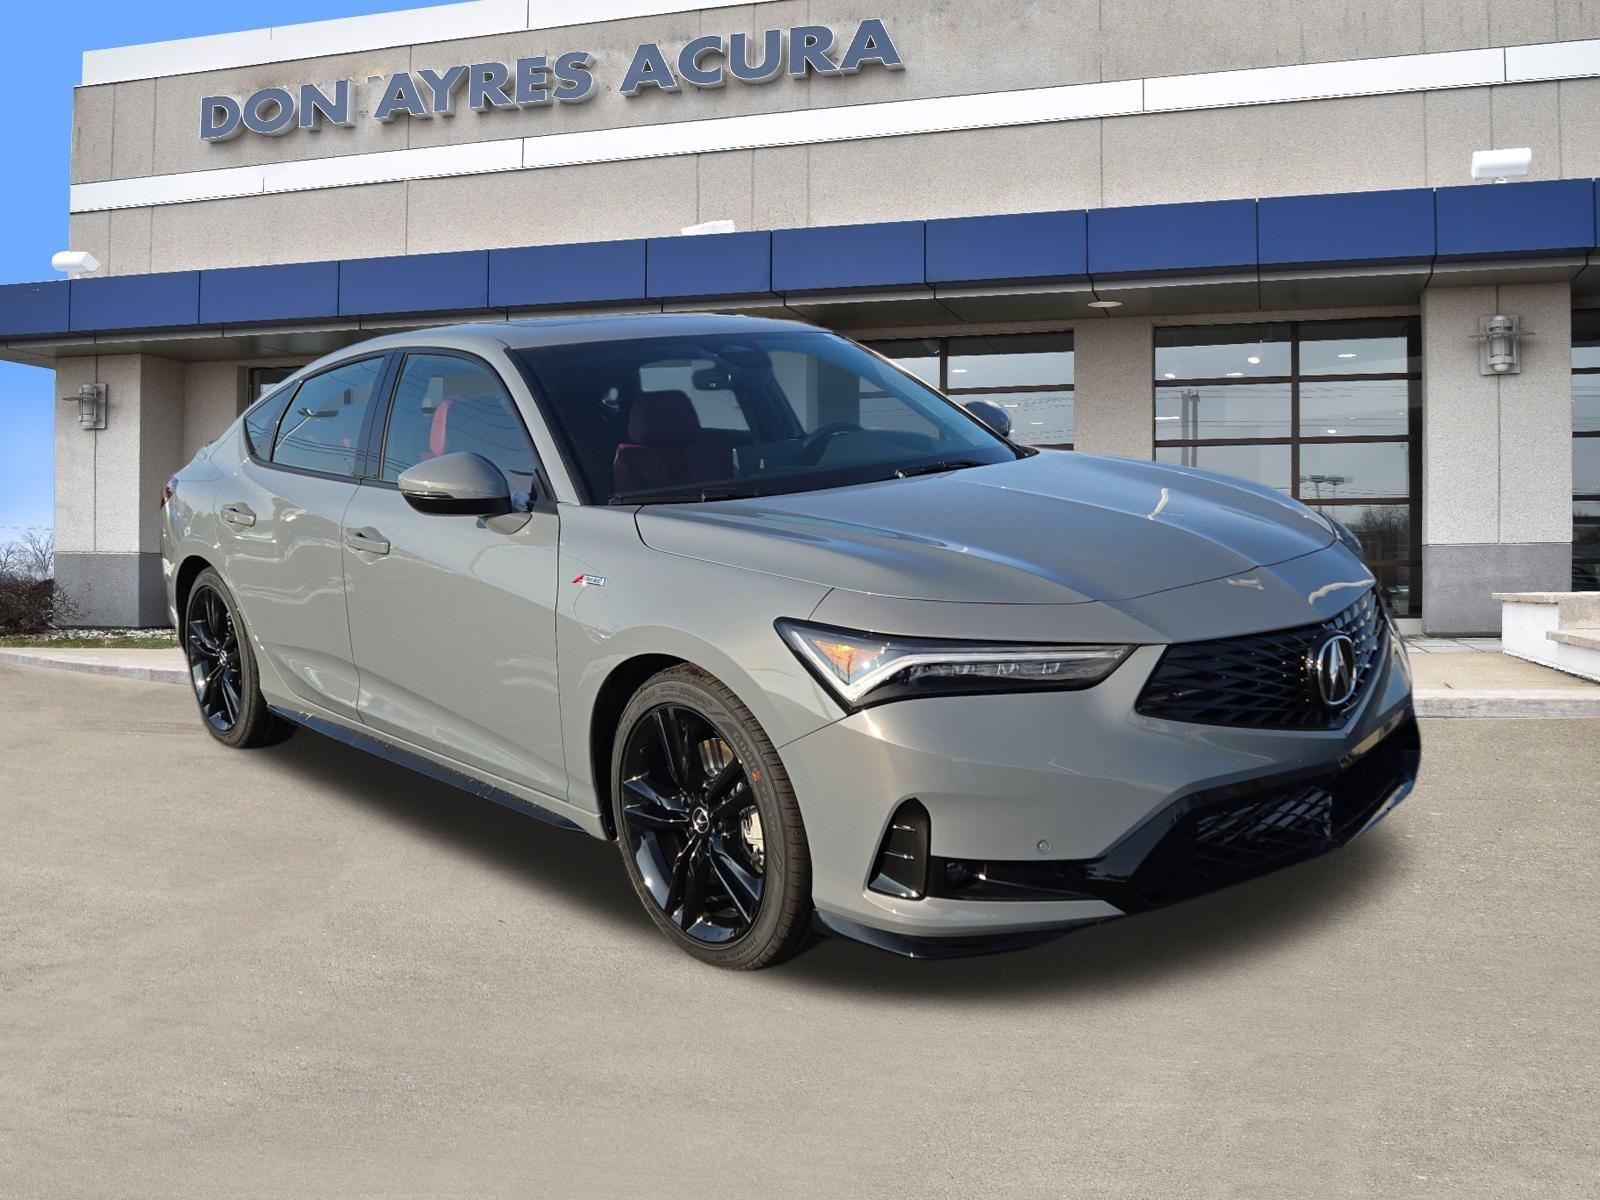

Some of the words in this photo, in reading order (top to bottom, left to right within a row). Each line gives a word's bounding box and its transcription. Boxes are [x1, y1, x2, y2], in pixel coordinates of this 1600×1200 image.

[199, 79, 356, 143] DON
[374, 51, 597, 123] AYRES
[618, 17, 905, 97] ACURA
